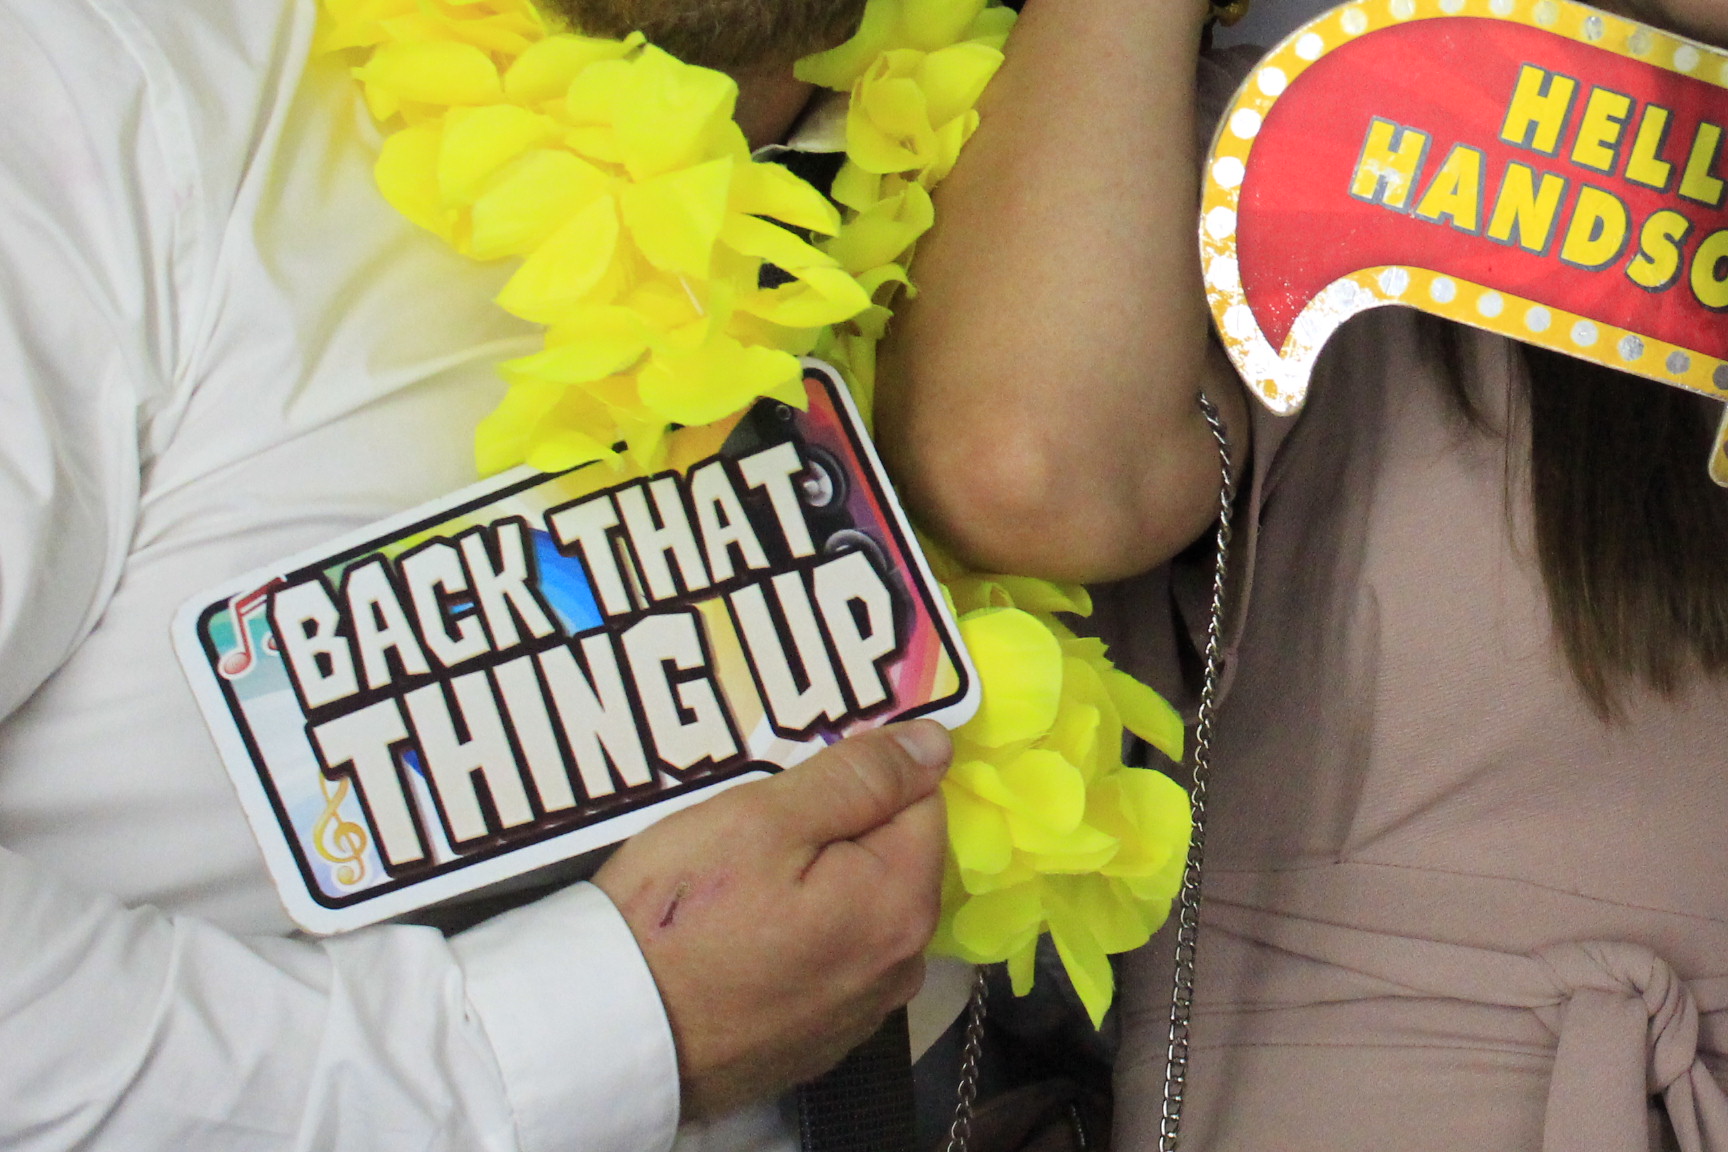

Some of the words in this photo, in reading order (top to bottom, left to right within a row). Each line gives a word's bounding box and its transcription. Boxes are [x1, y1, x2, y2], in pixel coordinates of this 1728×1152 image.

[273, 516, 552, 710] BACK
[552, 443, 815, 617] THAT
[310, 608, 744, 868] THING
[729, 551, 897, 734] UP
